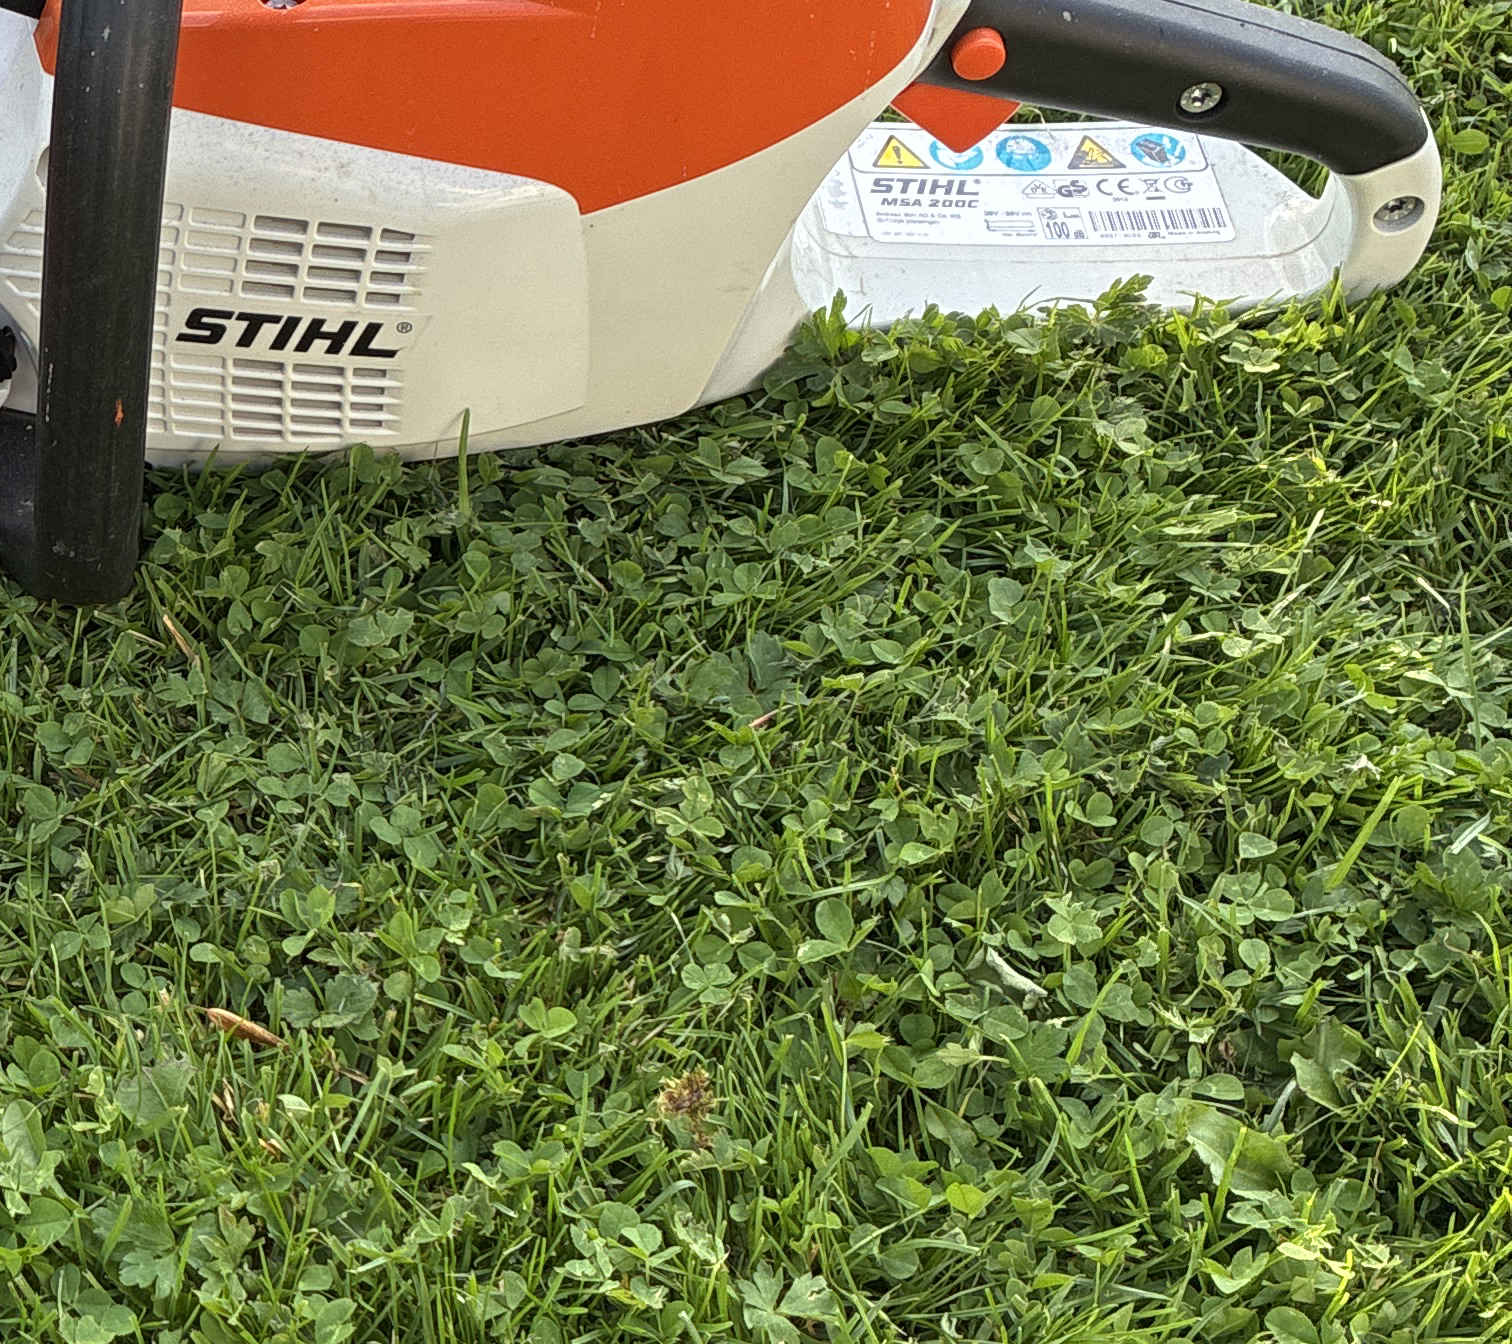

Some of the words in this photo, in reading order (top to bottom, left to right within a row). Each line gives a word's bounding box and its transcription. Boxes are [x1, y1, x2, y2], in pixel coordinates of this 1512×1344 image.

[880, 198, 922, 207] MSA
[928, 199, 979, 208] 200C
[1046, 221, 1070, 239] 100
